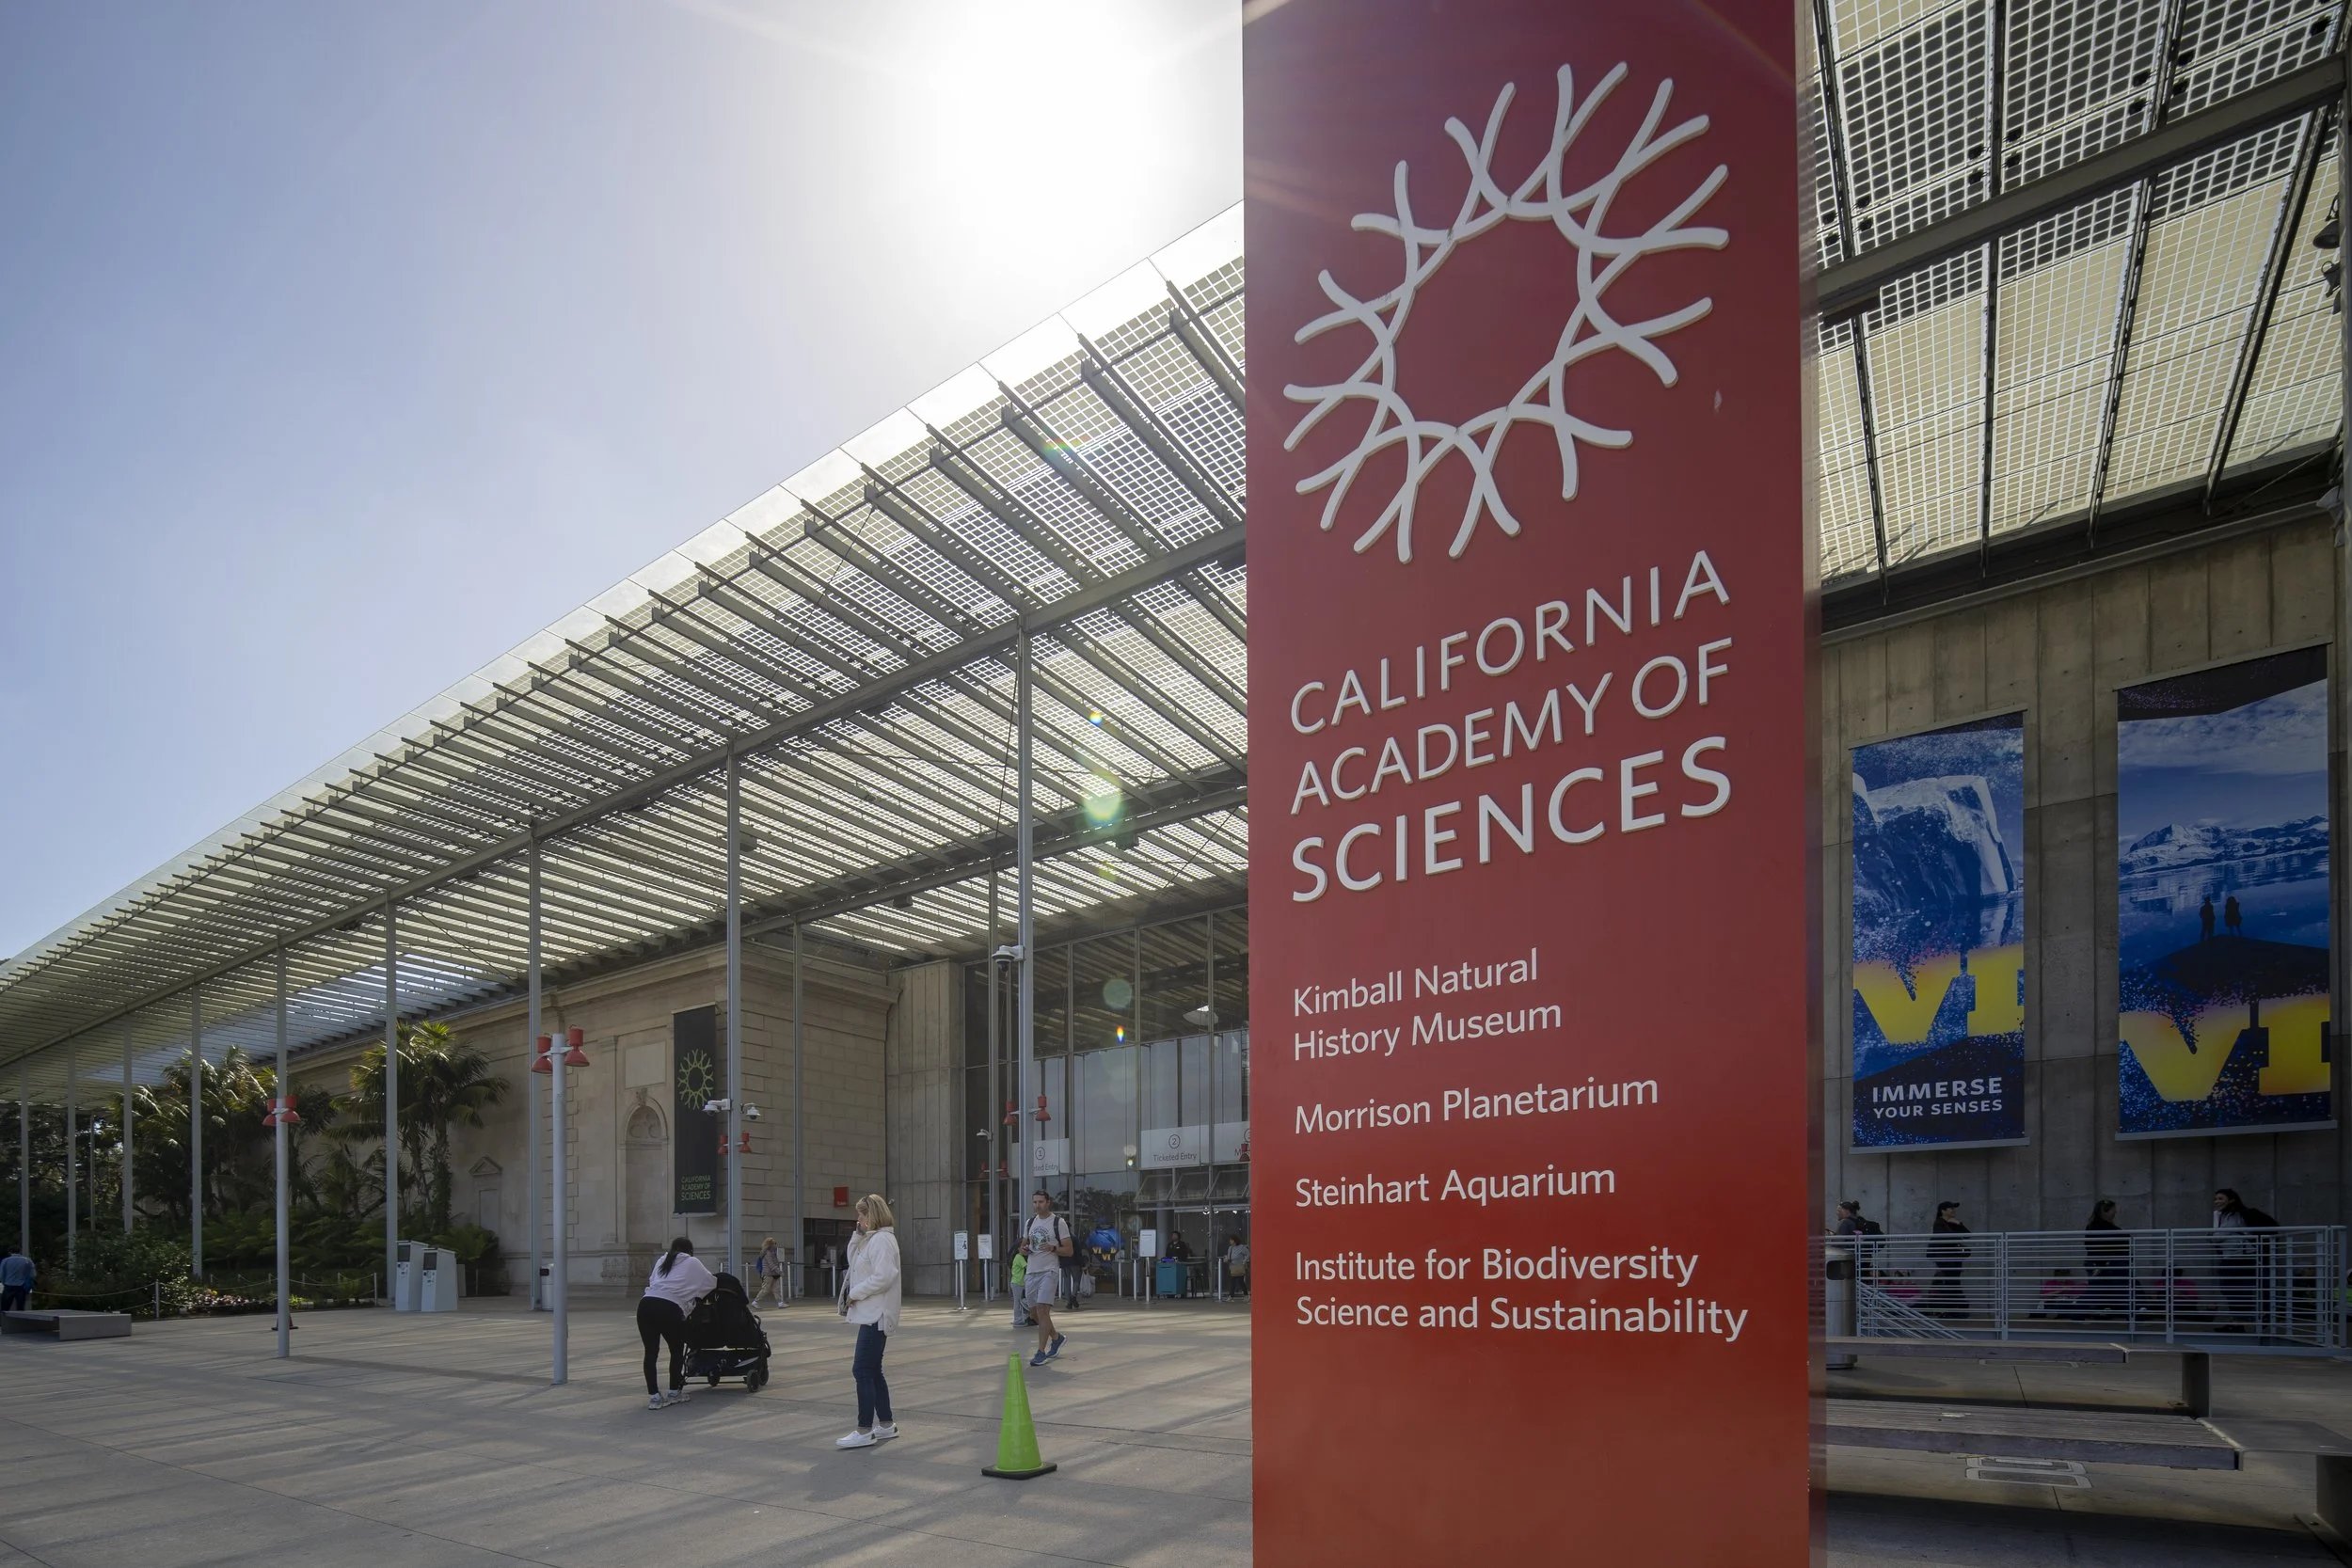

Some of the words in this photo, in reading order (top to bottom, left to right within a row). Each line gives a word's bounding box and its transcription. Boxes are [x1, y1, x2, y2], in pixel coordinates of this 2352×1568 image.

[1291, 549, 1731, 734] CALIFORNIA
[1291, 673, 1613, 815] ACADEMY
[1631, 637, 1732, 719] OF
[1292, 736, 1732, 902] SCIENCES
[1294, 971, 1403, 1017] Kimball
[1415, 947, 1538, 998] Natural
[1294, 1024, 1401, 1061] History
[1411, 1005, 1562, 1046] Museum
[1295, 1099, 1431, 1134] Morrison
[1443, 1076, 1659, 1121] Planetarium
[1872, 1077, 2003, 1102] IMMERSE
[1873, 1105, 1924, 1119] YOUR
[1931, 1099, 2003, 1116] SENSES
[681, 1174, 711, 1183] CALIFORNIA
[1044, 1163, 1058, 1172] Entry
[1152, 1153, 1179, 1163] Ticketed
[1180, 1152, 1198, 1161] Entry
[681, 1190, 711, 1201] SCIENCES
[1295, 1172, 1430, 1208] Steinhart
[1440, 1164, 1616, 1206] Aquarium
[1295, 1249, 1415, 1280] Institute
[1425, 1248, 1471, 1279] for
[1483, 1246, 1699, 1288] Biodiversity
[1296, 1296, 1408, 1326] Science
[1419, 1297, 1478, 1328] and
[1490, 1297, 1749, 1342] Sustainability
